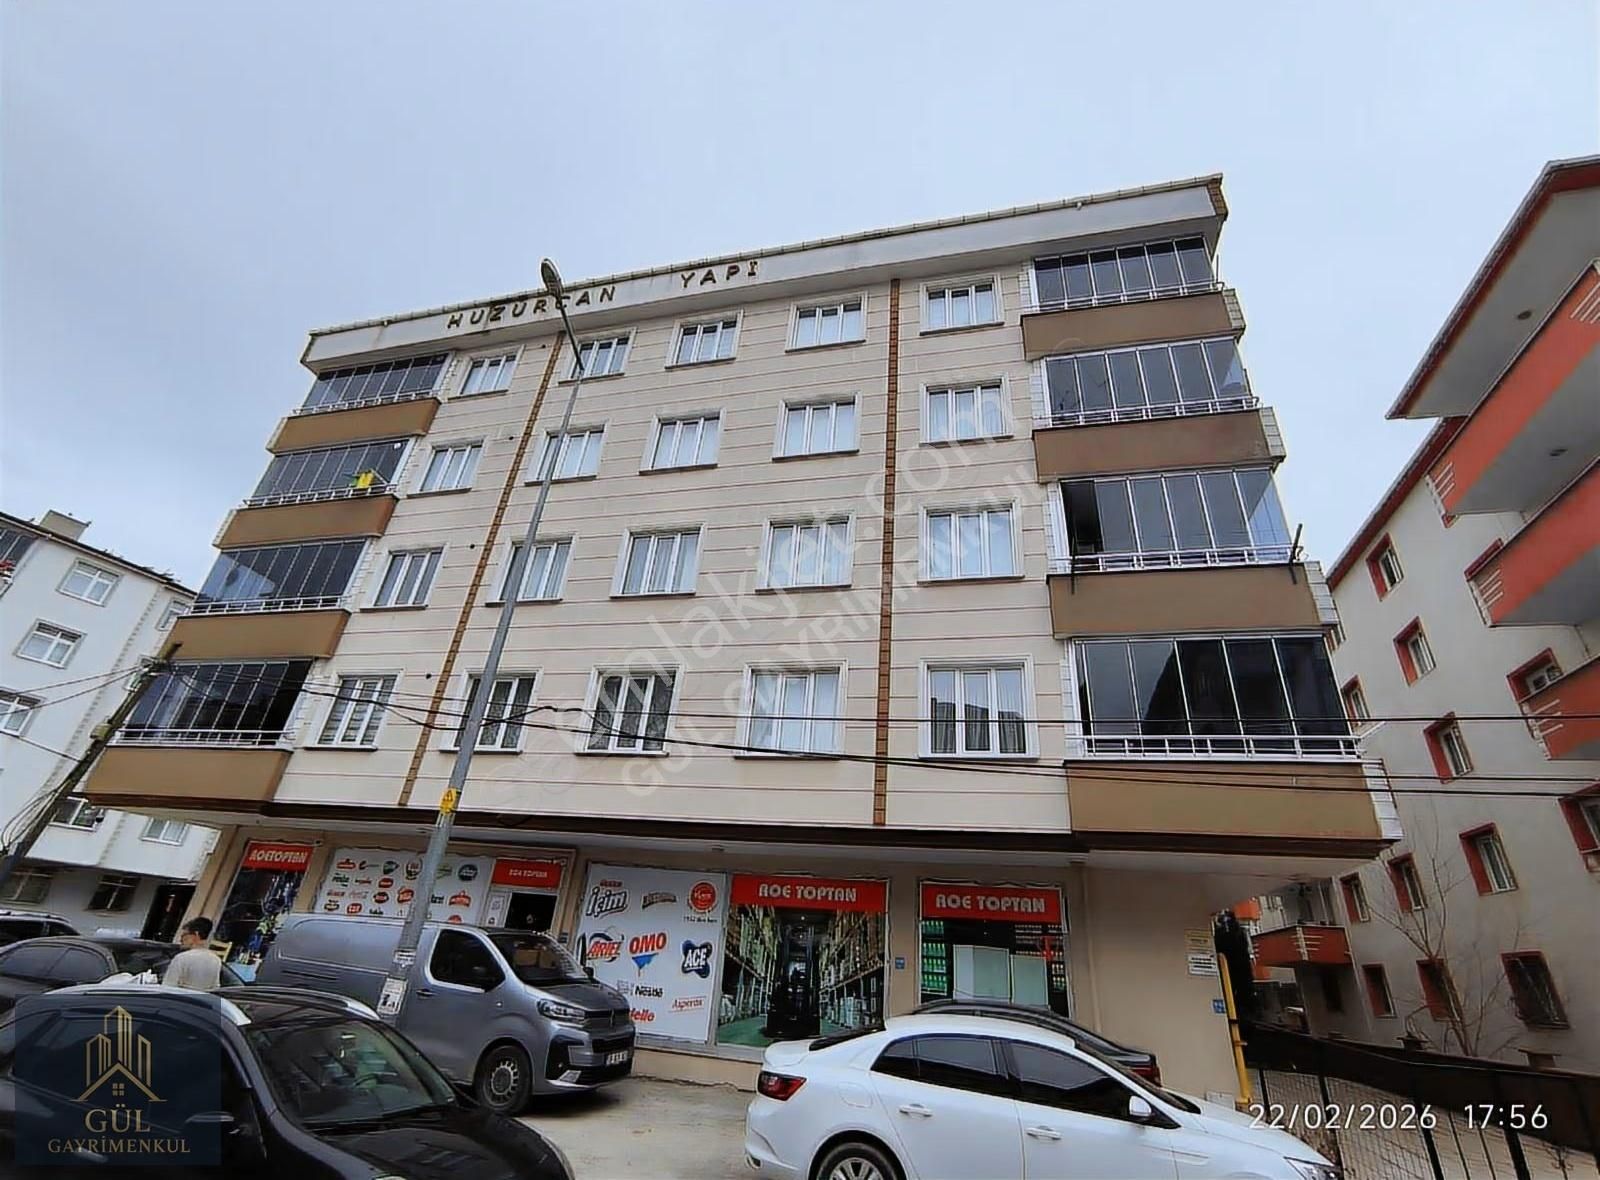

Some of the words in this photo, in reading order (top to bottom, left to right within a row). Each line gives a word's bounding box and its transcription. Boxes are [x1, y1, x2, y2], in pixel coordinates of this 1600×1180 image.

[447, 286, 616, 328] HUZURCAN
[795, 885, 857, 902] TOPTAN
[976, 895, 1046, 913] TOPTAN
[630, 932, 667, 955] OMO
[684, 947, 707, 969] ACE
